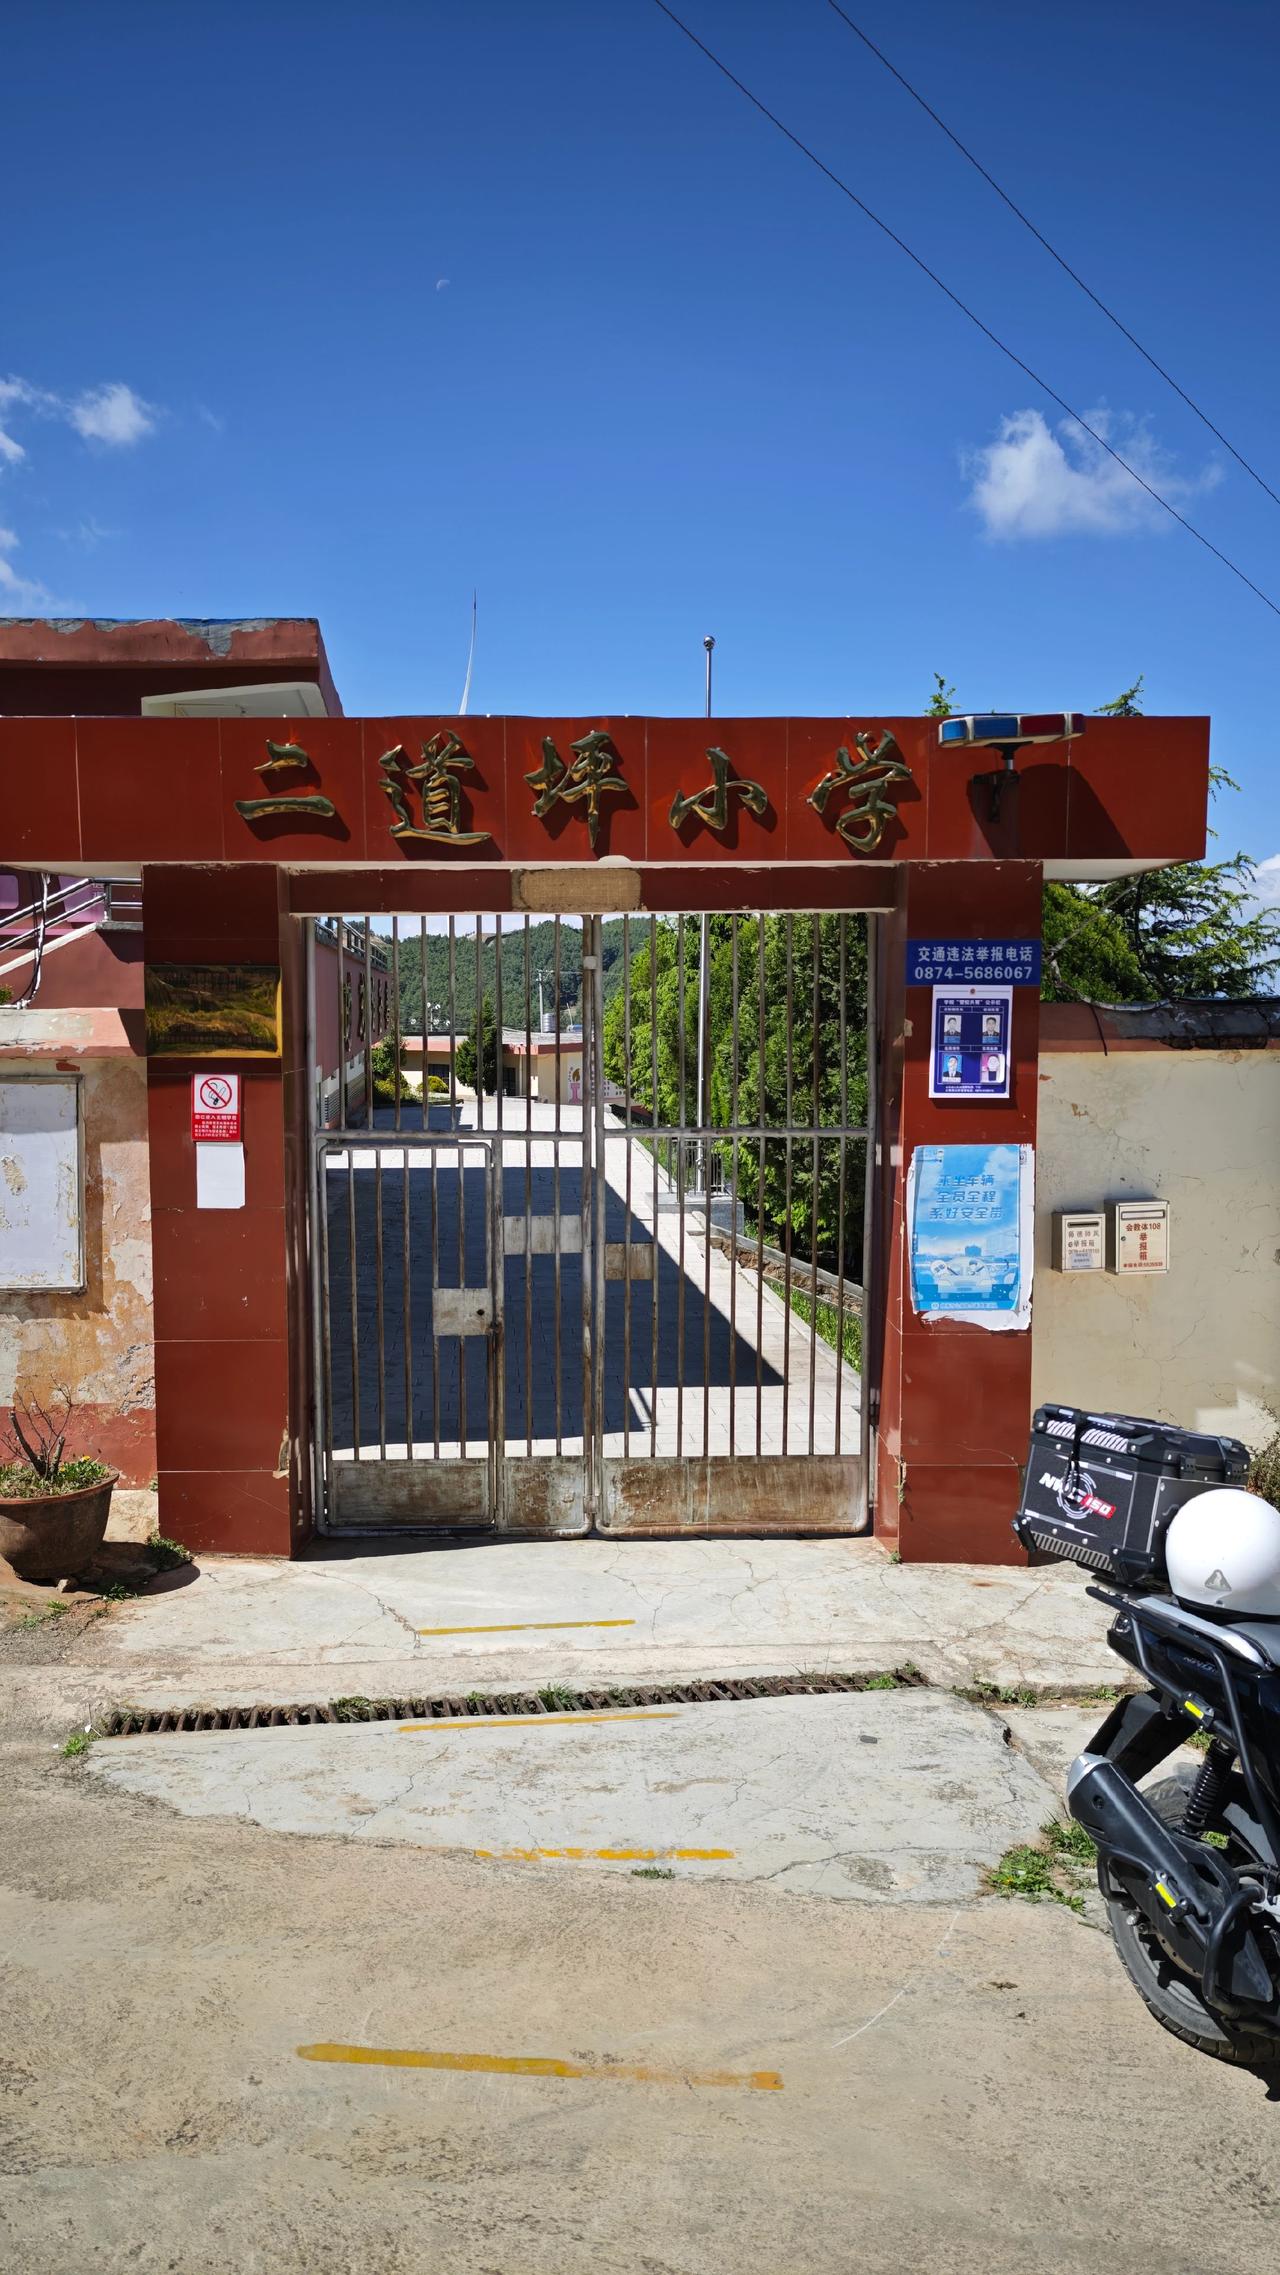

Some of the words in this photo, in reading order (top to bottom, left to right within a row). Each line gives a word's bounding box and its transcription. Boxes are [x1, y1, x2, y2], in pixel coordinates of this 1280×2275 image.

[234, 729, 912, 852] 二道坪小学
[918, 946, 1033, 962] 交通违法举报电话
[915, 967, 1033, 980] 0874-5686067
[937, 1174, 995, 1187] 乘坐车辆
[936, 1191, 996, 1203] 全员全程
[929, 1206, 1003, 1219] 系好安全带
[1139, 1232, 1148, 1260] 举报箱
